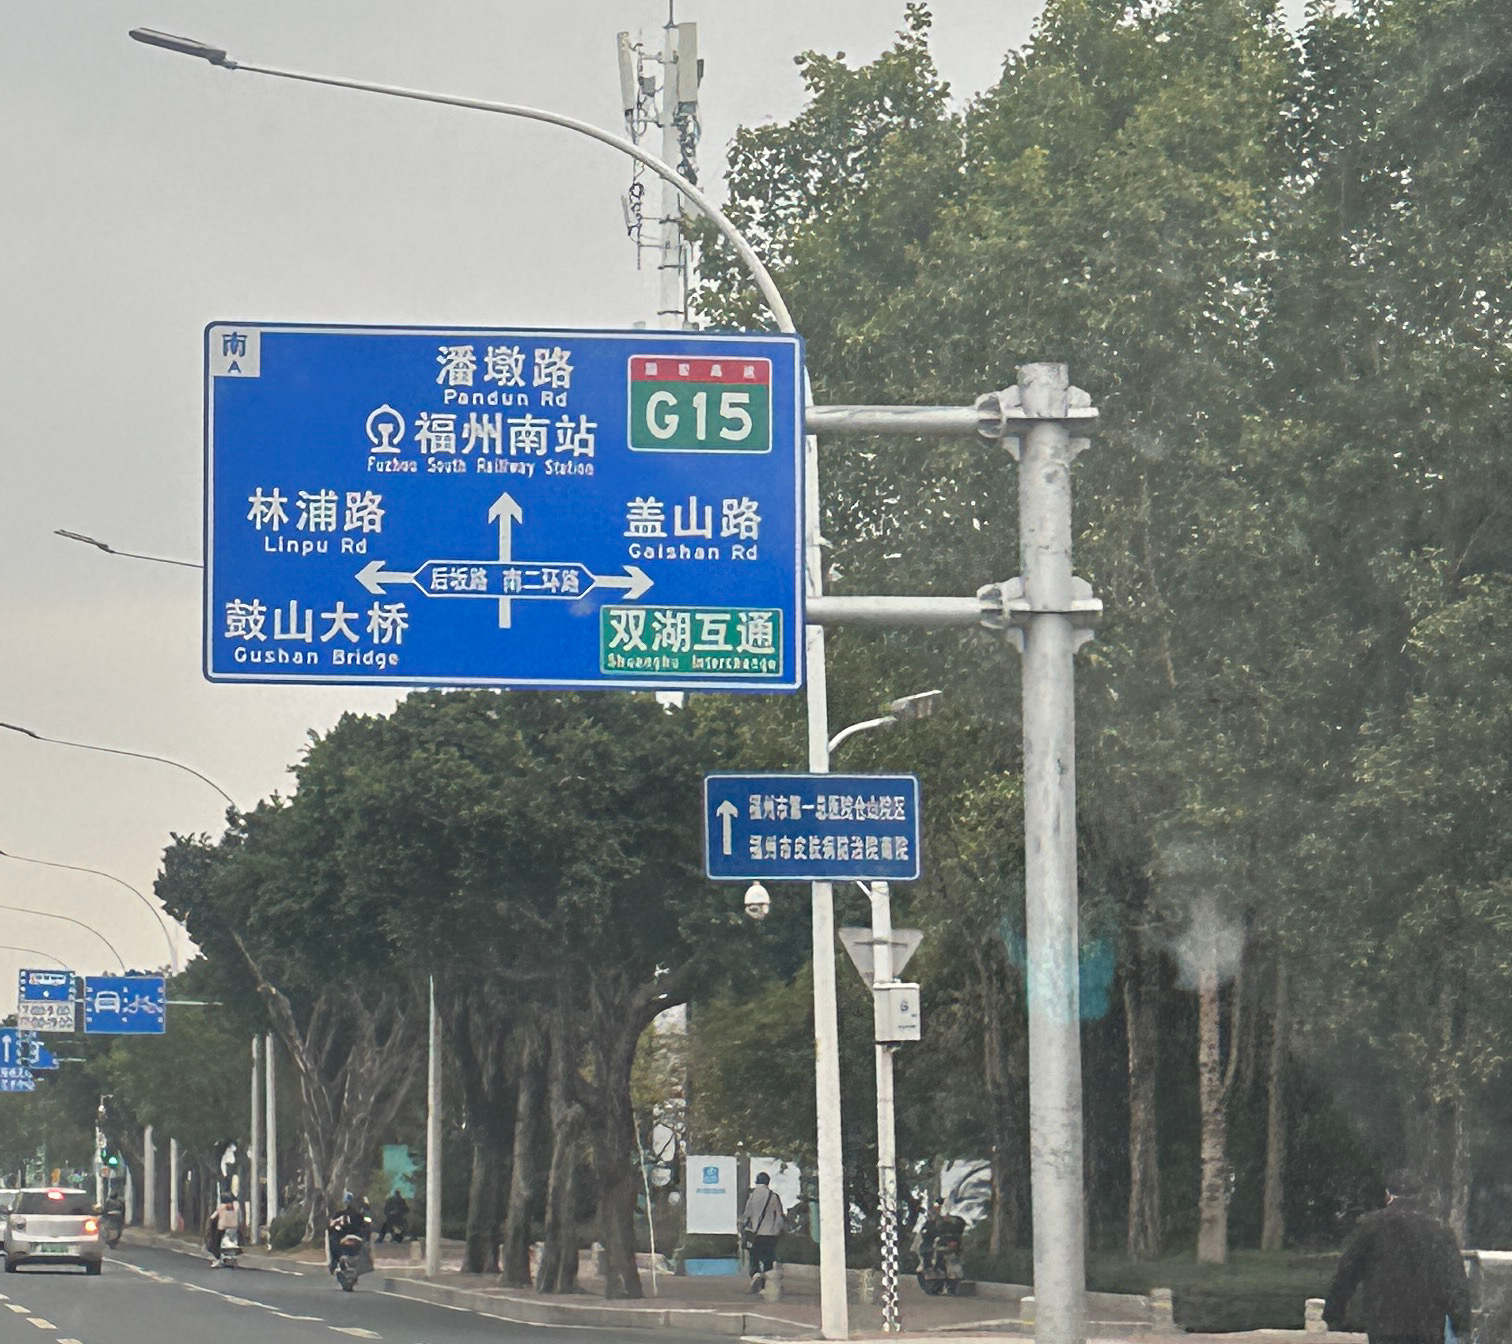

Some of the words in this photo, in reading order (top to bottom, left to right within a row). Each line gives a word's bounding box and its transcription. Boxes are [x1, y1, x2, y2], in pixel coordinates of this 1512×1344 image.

[222, 331, 248, 357] 南
[436, 345, 574, 388] 潘墩路
[443, 389, 528, 406] Pandun
[541, 390, 568, 407] Rd
[646, 390, 753, 441] G15
[414, 411, 598, 457] 福州南站
[367, 456, 418, 472] Fuzhou
[427, 457, 466, 473] South
[477, 457, 535, 478] Railway
[545, 458, 594, 476] Station
[247, 487, 385, 533] 林浦路
[623, 495, 762, 540] 盖山路
[264, 536, 328, 556] Linpu
[341, 537, 367, 554] Rd
[628, 543, 719, 560] Gaishan
[731, 544, 757, 561] Rd
[502, 567, 580, 593] 南二环路
[224, 598, 409, 645] 鼓山大桥
[608, 609, 776, 654] 双湖互通
[234, 646, 319, 664] Gushan
[332, 648, 400, 670] Bridge
